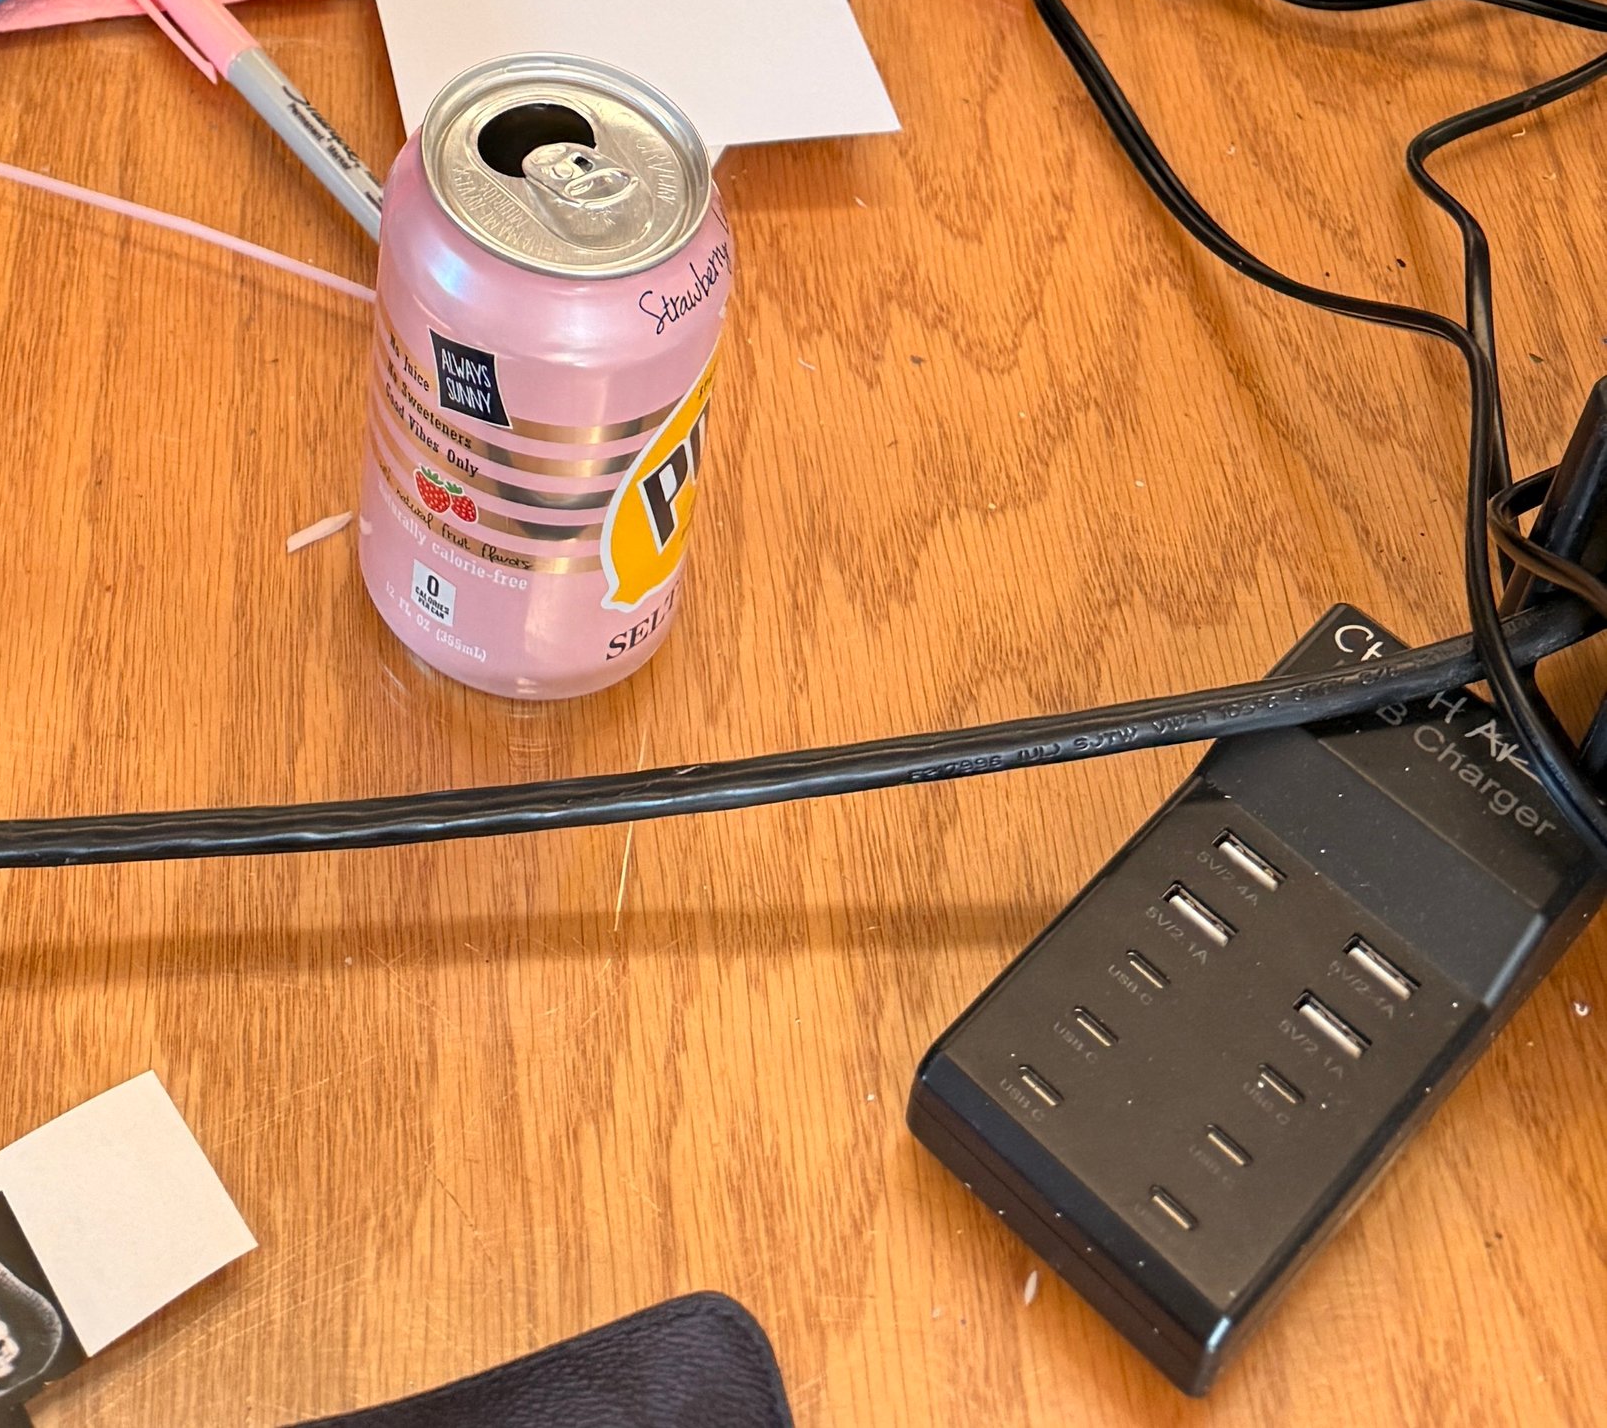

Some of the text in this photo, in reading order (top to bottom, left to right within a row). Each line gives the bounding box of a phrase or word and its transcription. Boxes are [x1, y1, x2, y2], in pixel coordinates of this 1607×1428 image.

[639, 242, 732, 335] Strawberry
[403, 355, 430, 392] Juice
[441, 347, 492, 389] ALWAYS
[401, 381, 473, 450] Sweeteners
[446, 378, 492, 416] SUNNY
[385, 381, 479, 478] Good Vibes Only
[396, 488, 434, 530] natural
[441, 523, 472, 551] fruit
[481, 543, 532, 570] flavors
[426, 574, 440, 598] 0
[432, 541, 528, 592] calorie-free
[414, 586, 451, 616] CALORIES
[417, 596, 446, 621] PER CAN
[416, 615, 432, 633] OZ
[435, 628, 488, 664] (355mL)
[1412, 724, 1557, 838] Charger
[1144, 903, 1211, 966] 5V/2.1A
